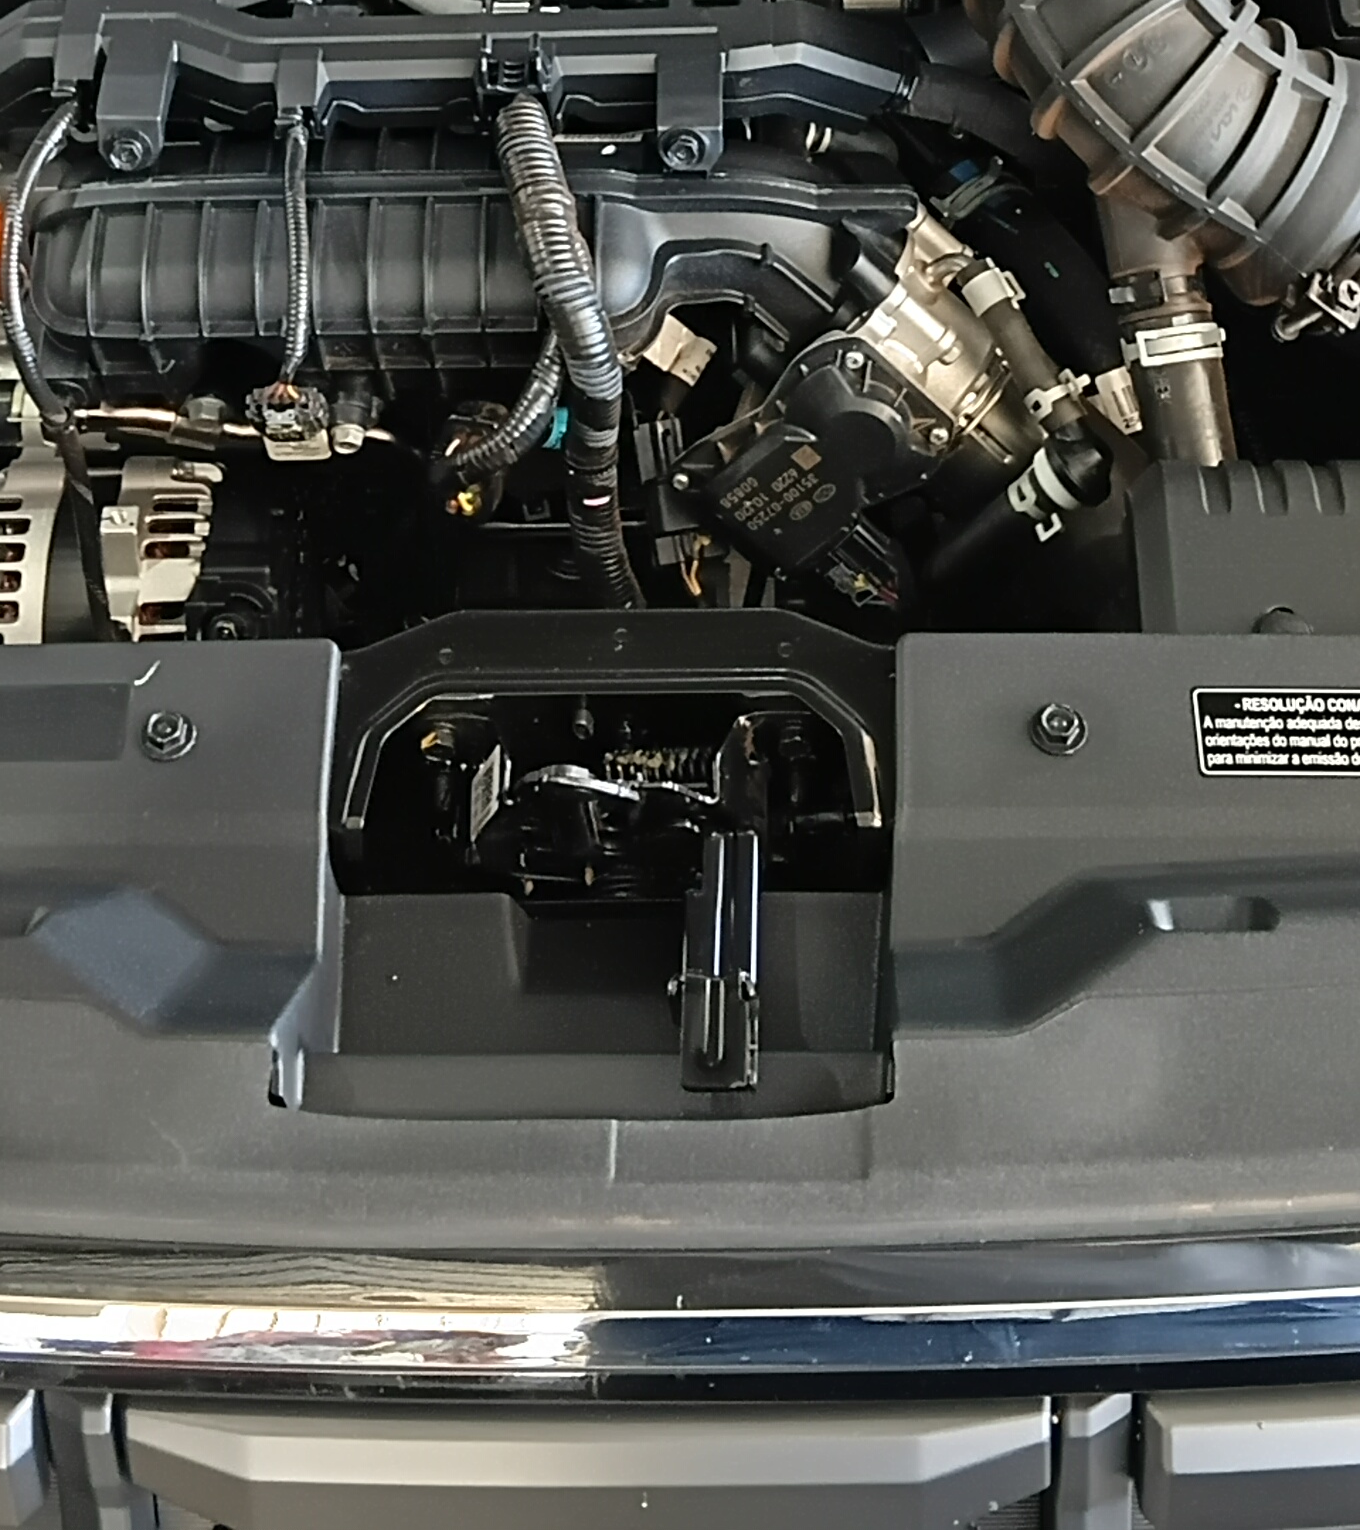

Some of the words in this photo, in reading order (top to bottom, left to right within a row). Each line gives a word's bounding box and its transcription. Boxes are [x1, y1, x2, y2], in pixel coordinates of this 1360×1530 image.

[1241, 695, 1325, 714] RESOLUÇÃO
[1203, 715, 1214, 729] A
[1272, 734, 1287, 747] do
[1289, 734, 1331, 747] manual
[1333, 734, 1348, 747] do
[1207, 753, 1234, 767] para
